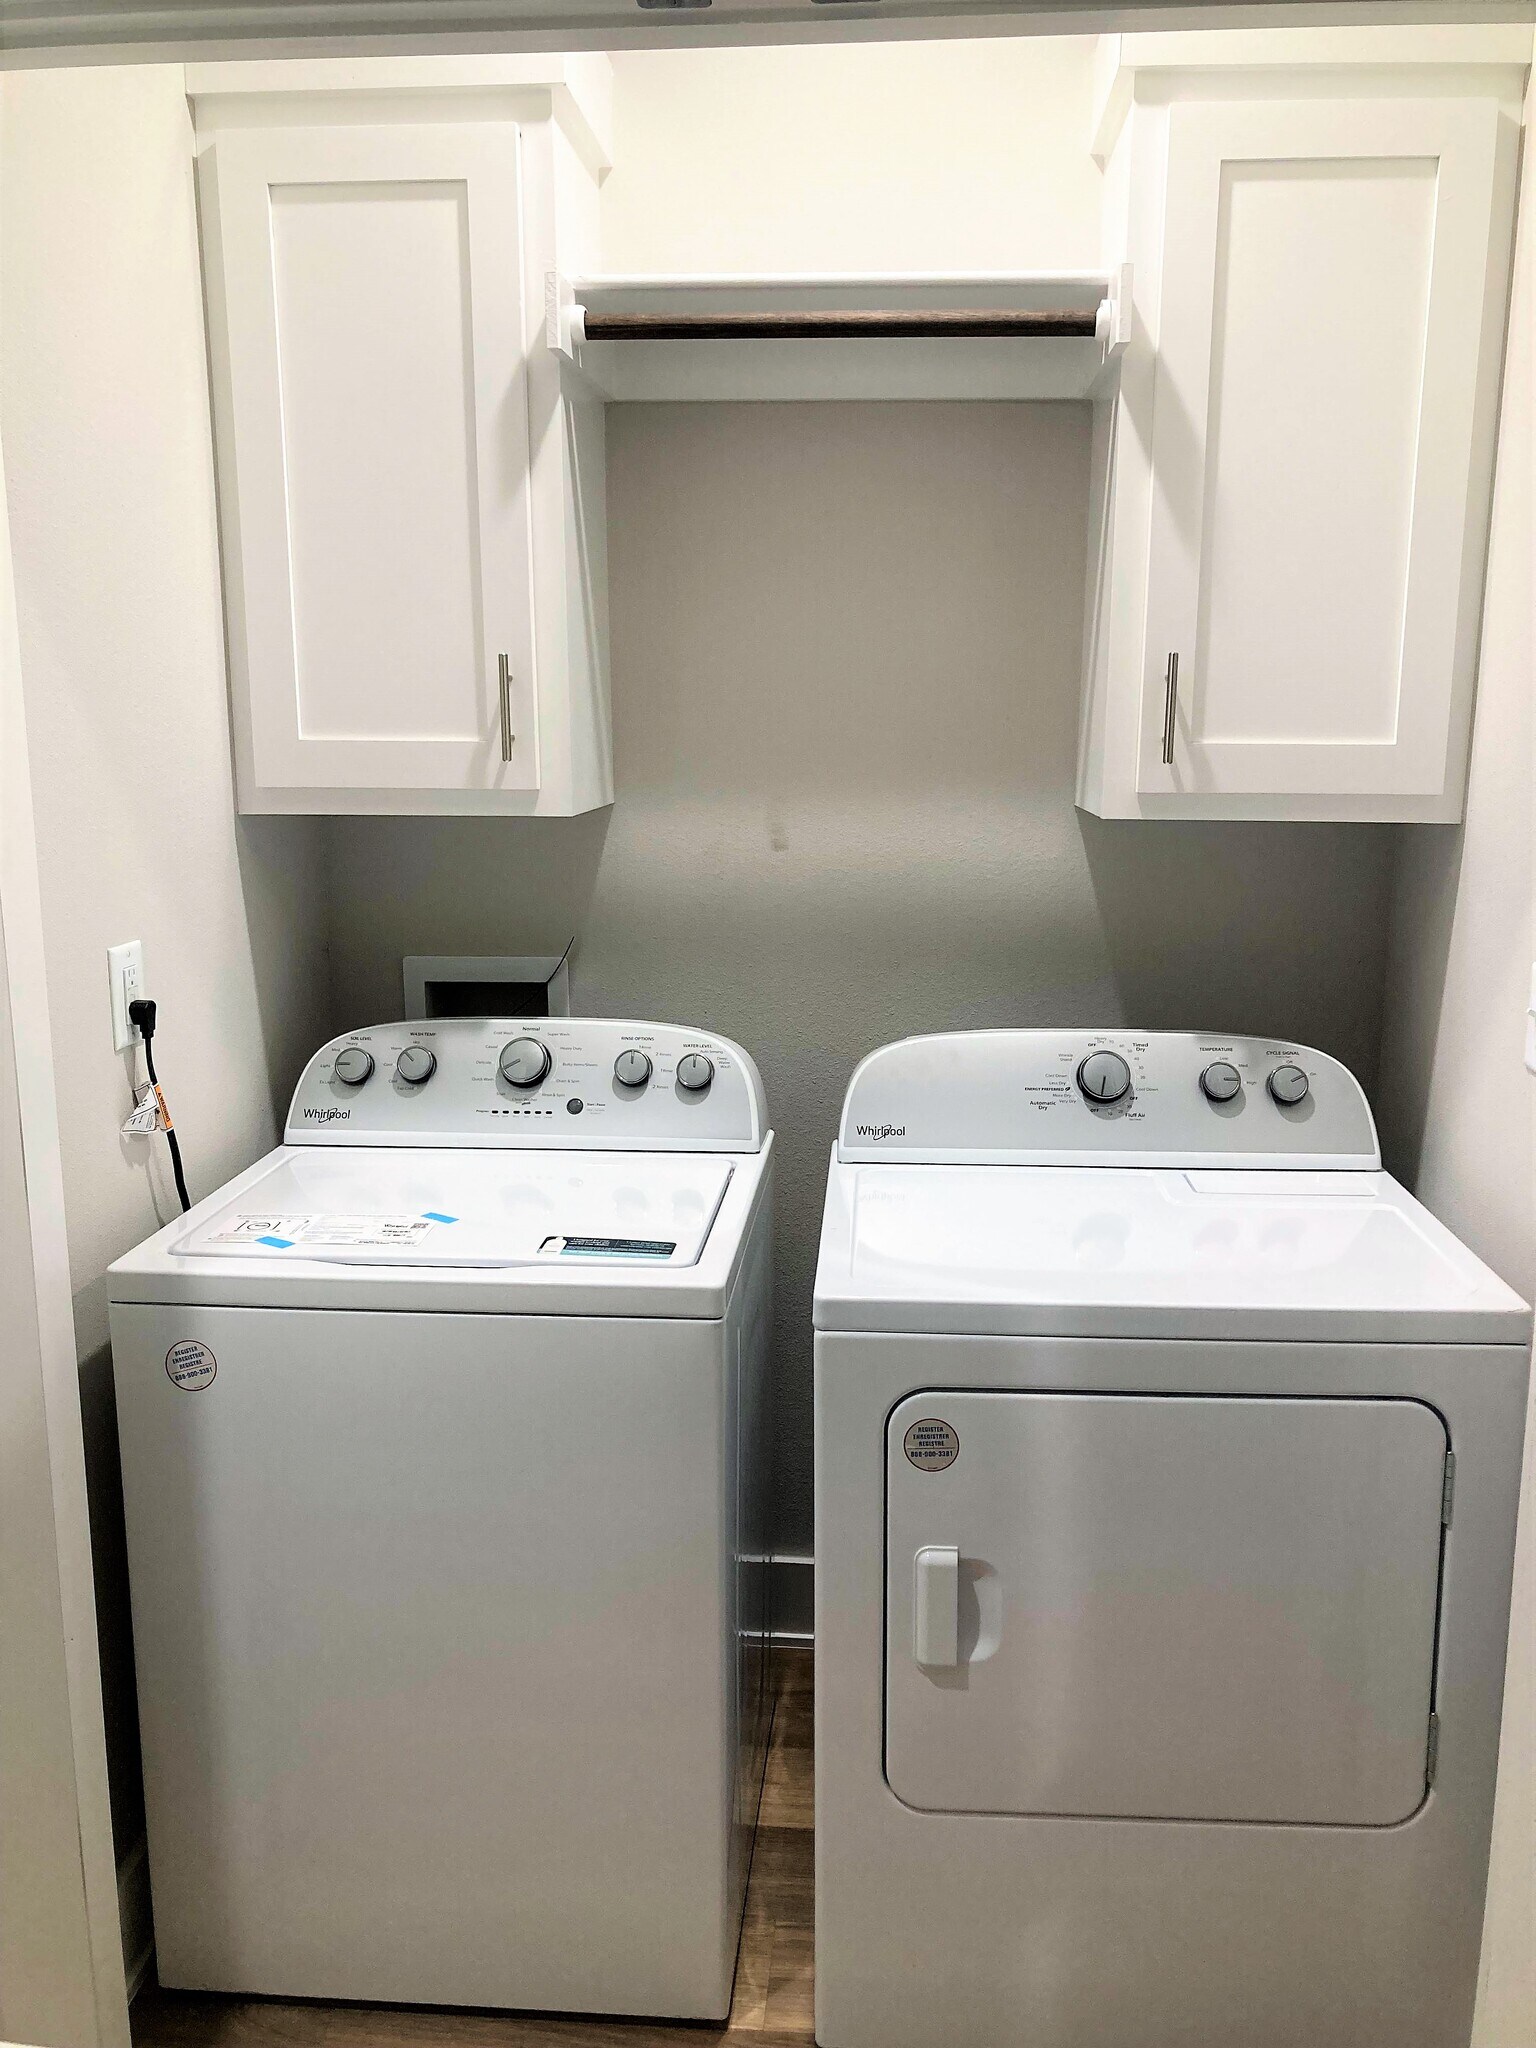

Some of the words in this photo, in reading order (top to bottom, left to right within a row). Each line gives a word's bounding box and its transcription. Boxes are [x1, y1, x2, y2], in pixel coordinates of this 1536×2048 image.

[303, 1108, 350, 1123] Whirlpool
[856, 1124, 906, 1140] Whirlpool
[174, 1346, 198, 1357] REGISTER
